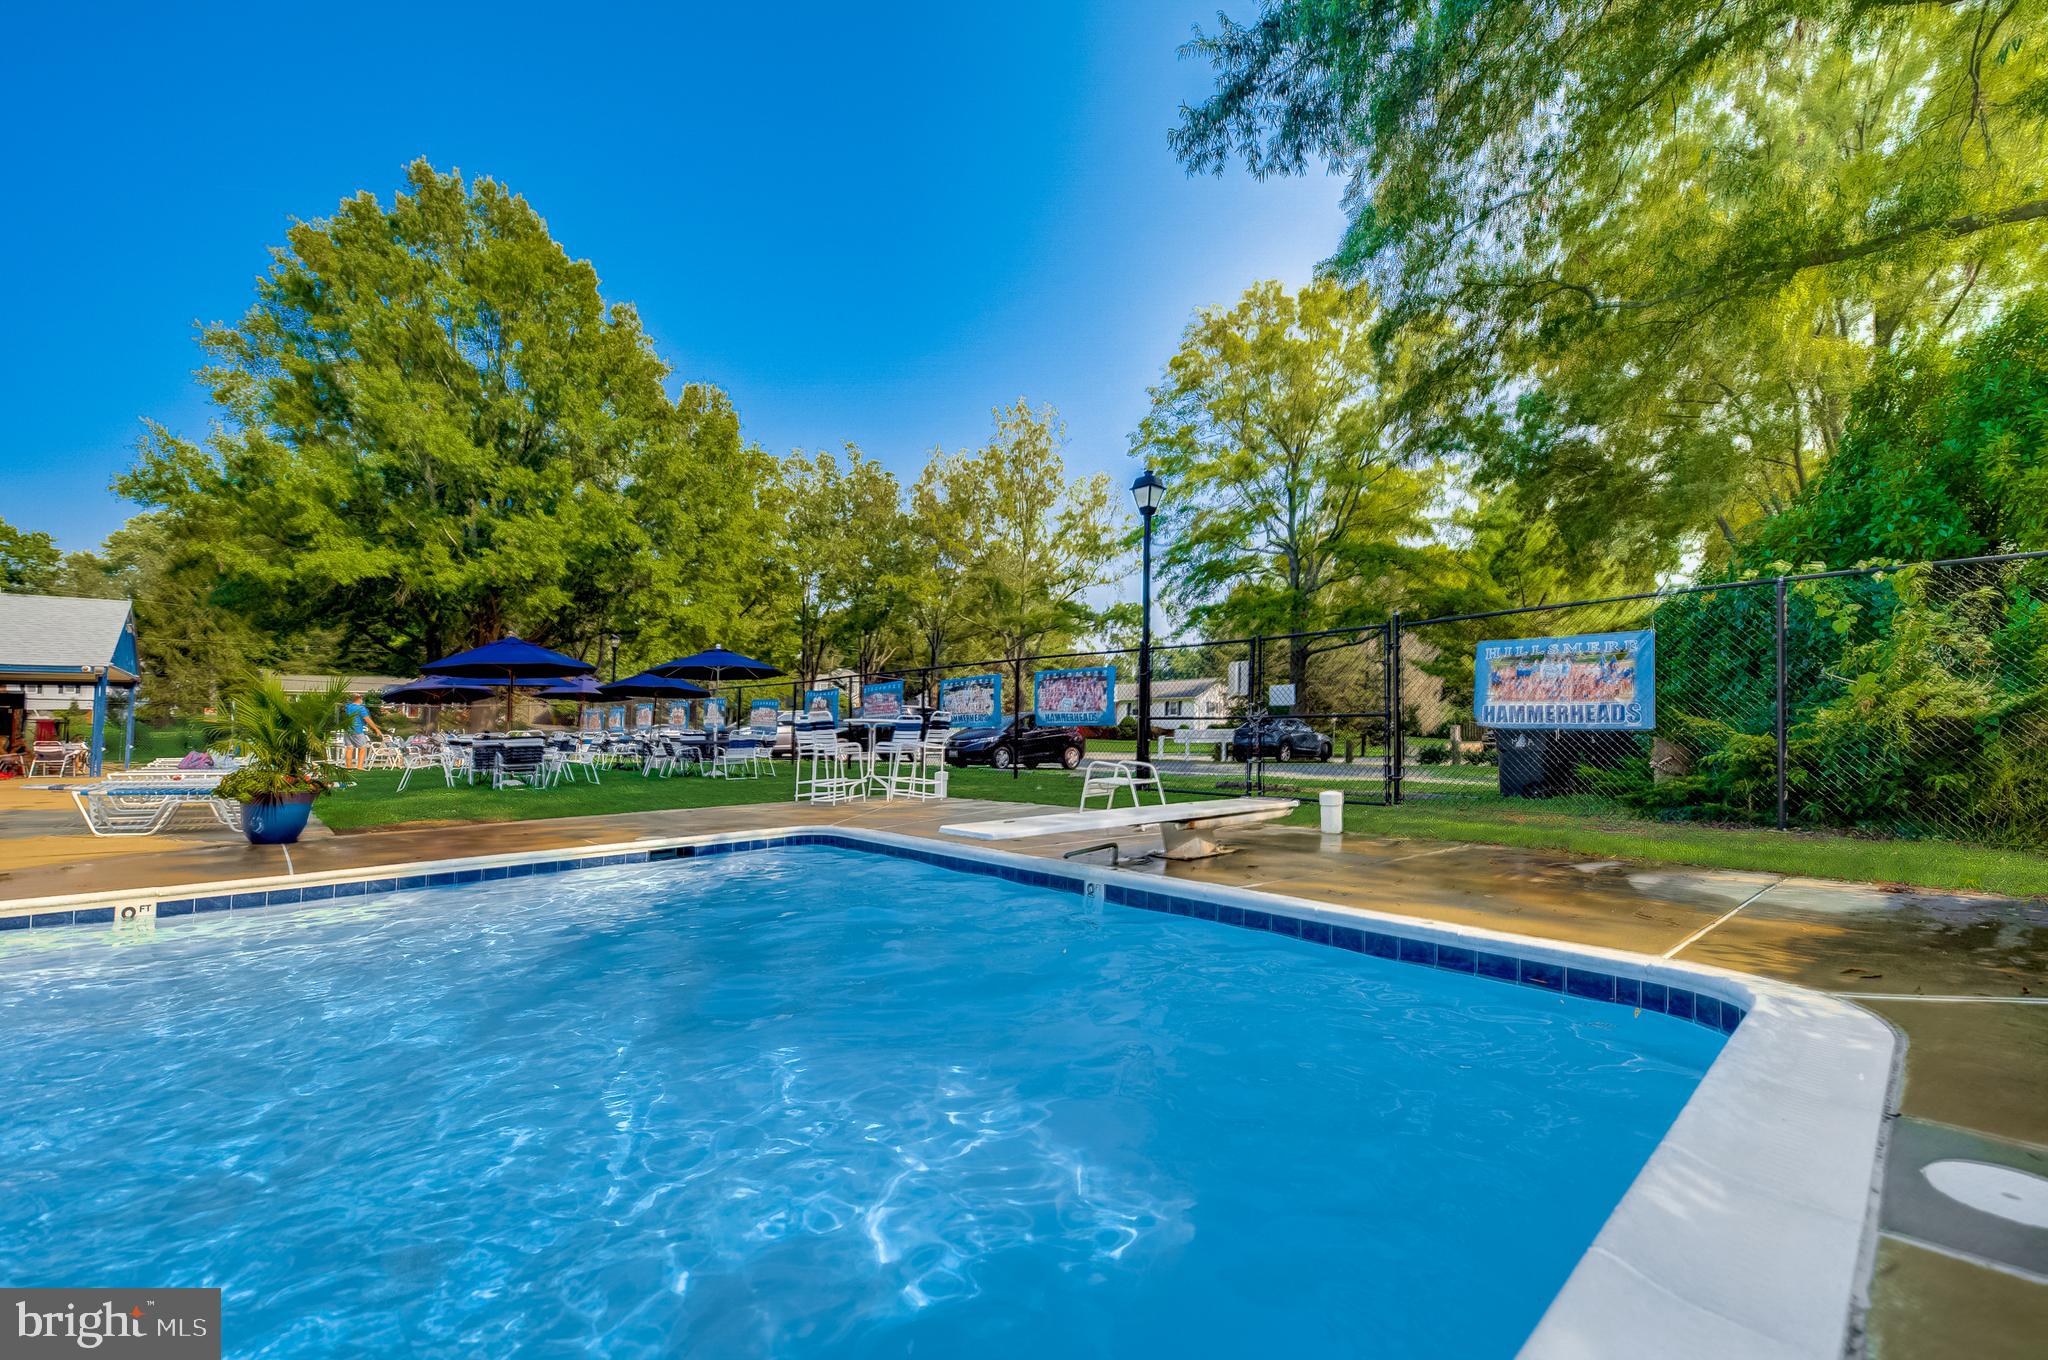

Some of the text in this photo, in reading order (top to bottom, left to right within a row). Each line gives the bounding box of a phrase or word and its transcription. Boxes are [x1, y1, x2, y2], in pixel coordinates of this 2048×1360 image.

[1485, 639, 1639, 660] HILLSMERE
[1482, 702, 1642, 724] HAMMERHEADS
[139, 904, 152, 912] FT
